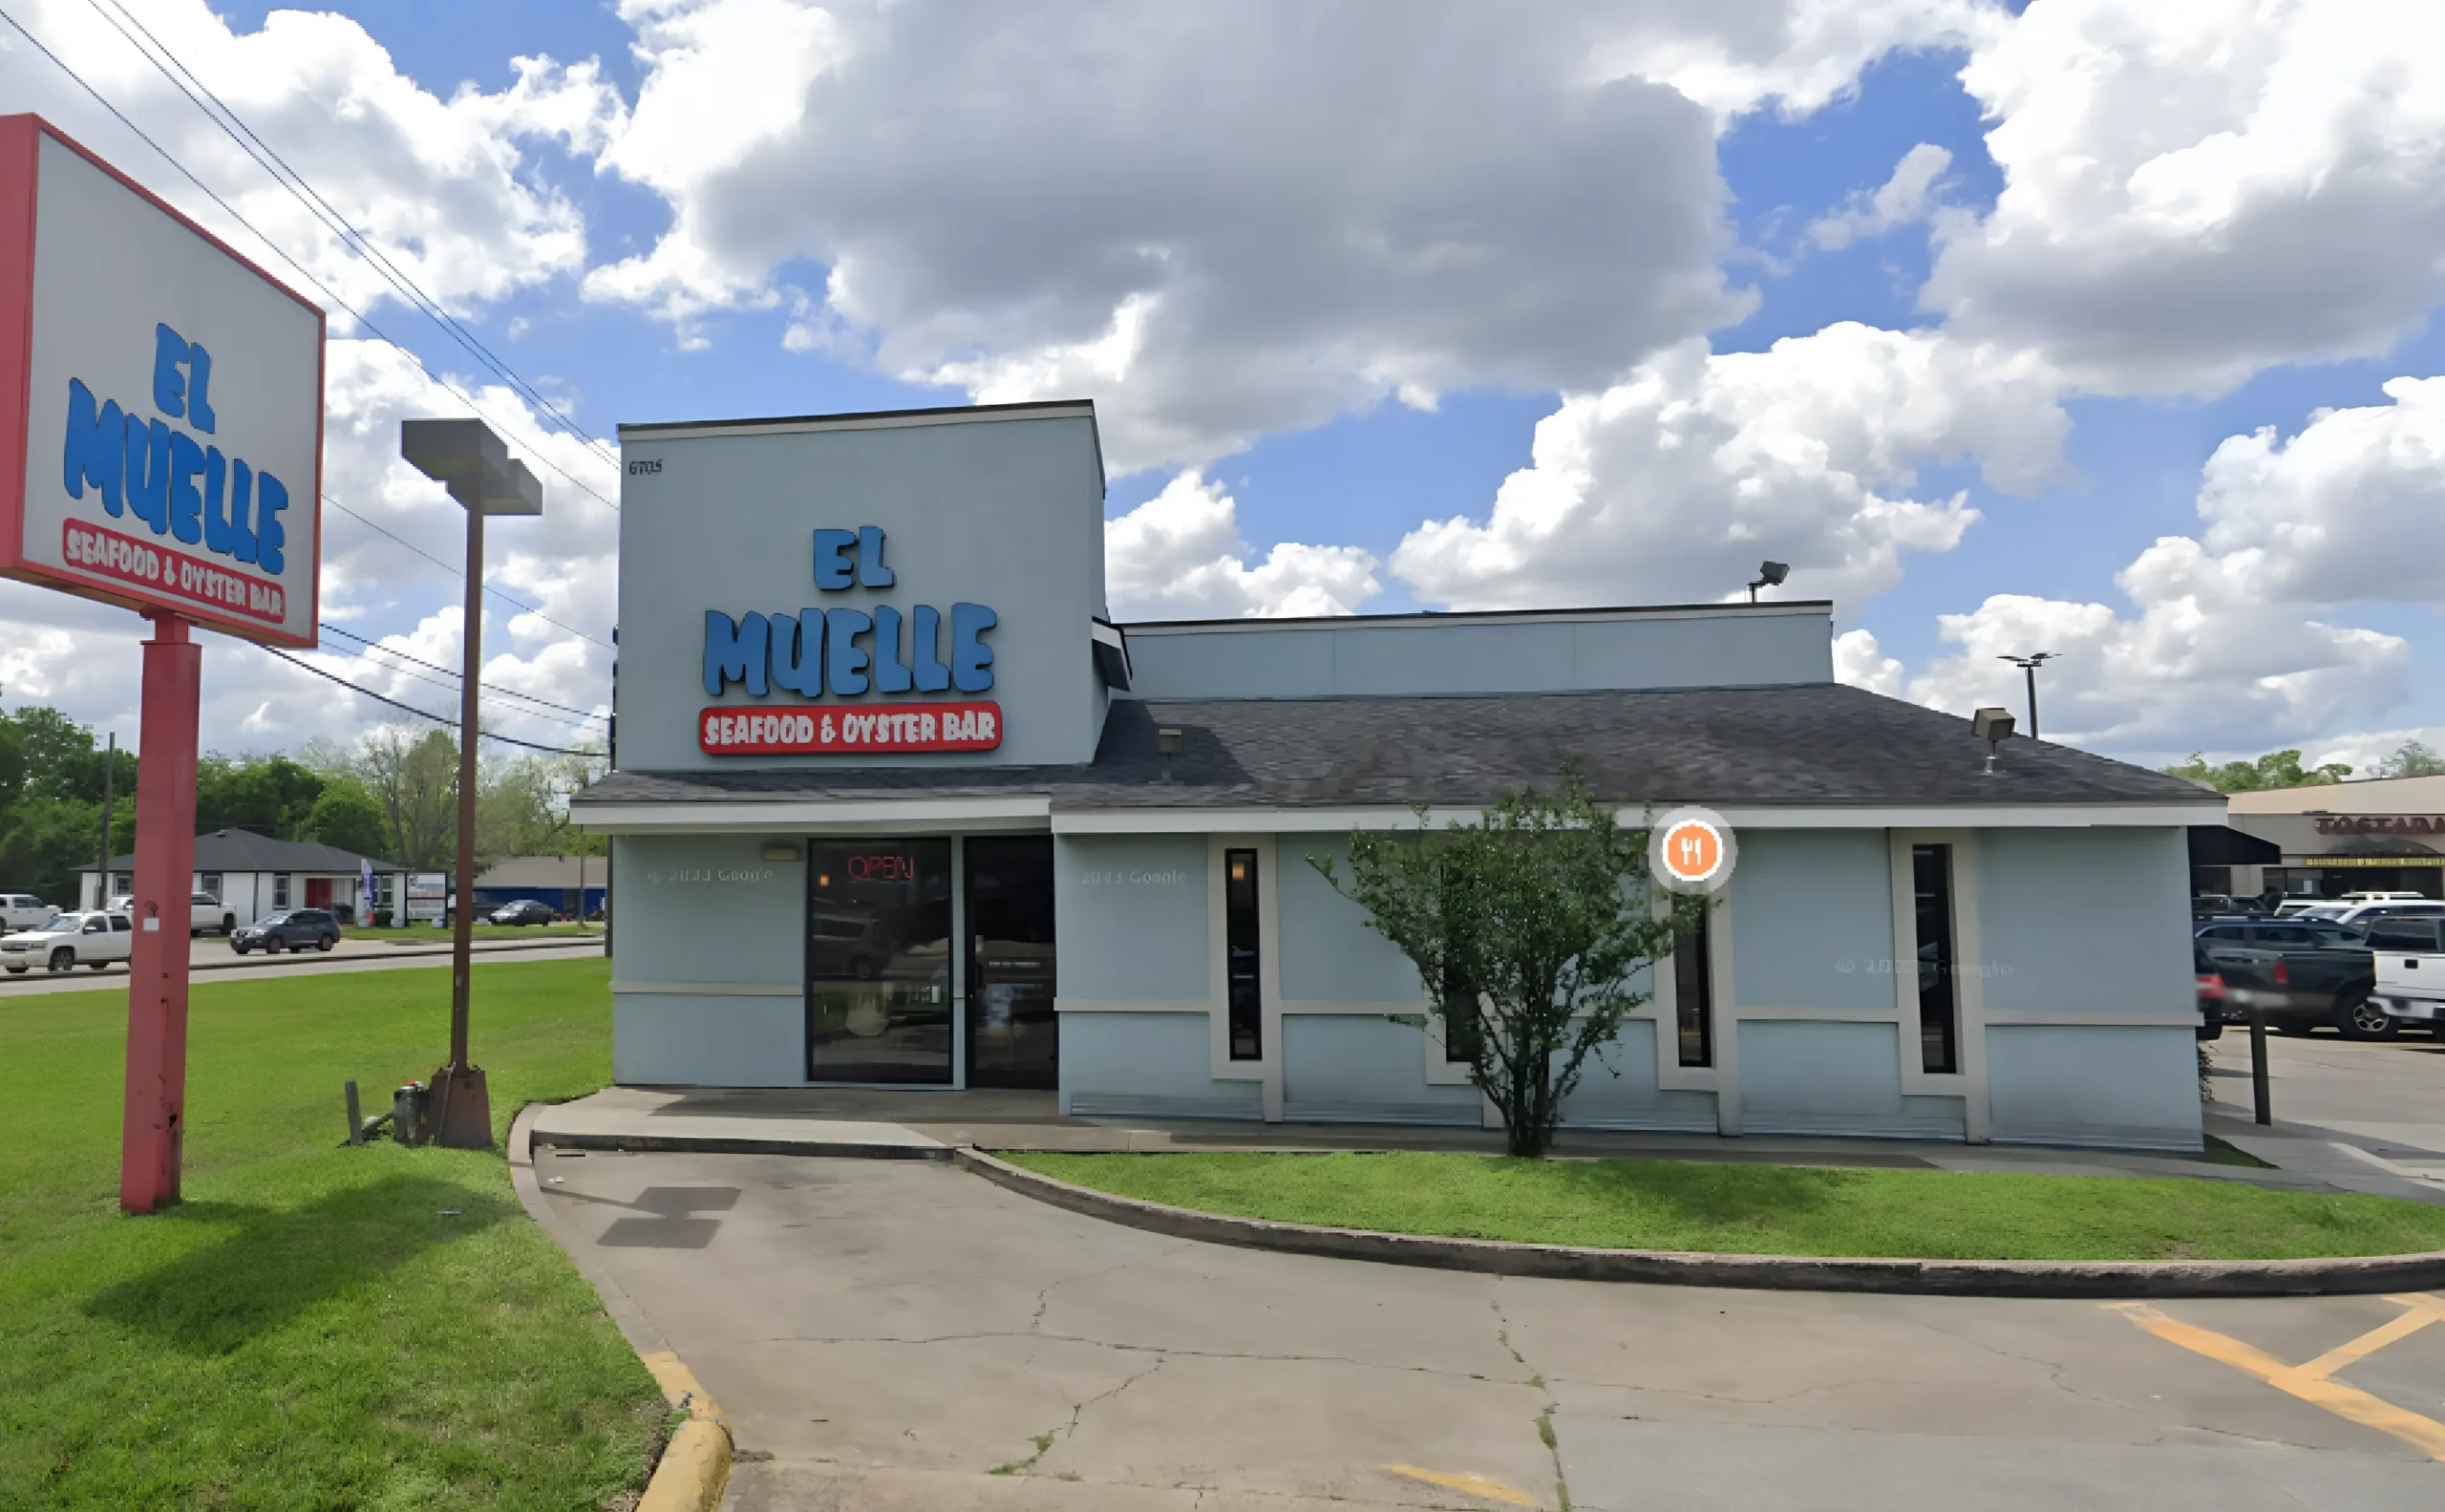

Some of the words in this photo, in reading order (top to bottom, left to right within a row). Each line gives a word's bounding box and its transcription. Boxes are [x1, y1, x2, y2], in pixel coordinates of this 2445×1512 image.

[153, 322, 216, 435] EL
[64, 377, 289, 575] MUELLE
[67, 528, 160, 581] SEAFOOD
[164, 556, 178, 586] &
[181, 561, 245, 606] OYSTER
[249, 583, 284, 615] BAR
[813, 525, 896, 590] EL
[703, 602, 998, 698] MUELLE
[705, 715, 814, 745] SEAFOOD
[820, 715, 837, 743] &
[842, 713, 936, 743] OYSTER
[943, 711, 995, 741] BAR
[847, 856, 914, 880] OPEN
